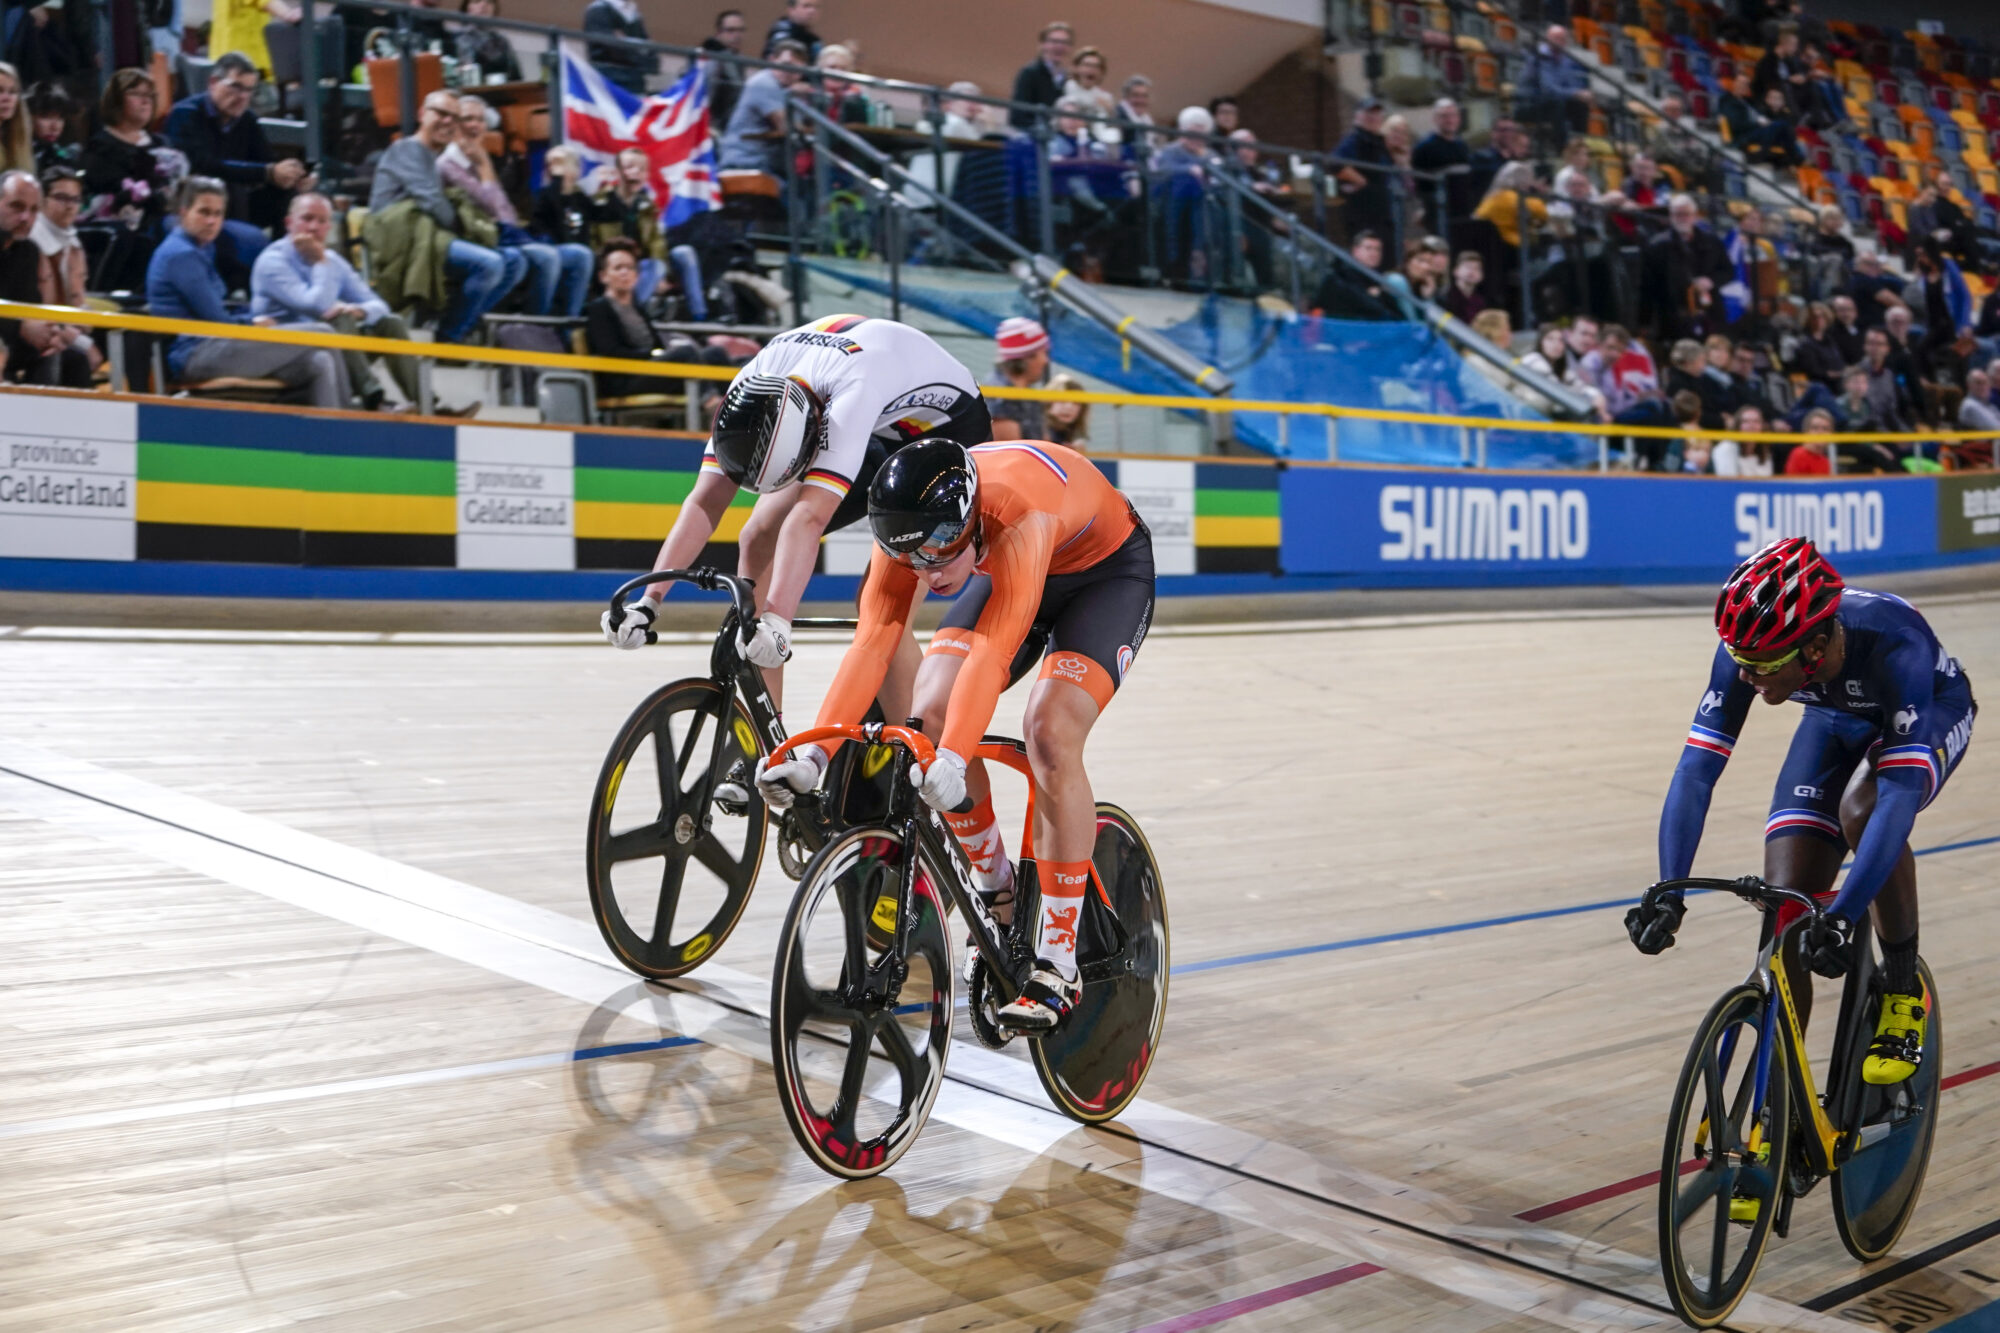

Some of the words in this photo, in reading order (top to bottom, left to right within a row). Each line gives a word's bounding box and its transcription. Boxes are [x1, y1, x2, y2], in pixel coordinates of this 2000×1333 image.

[10, 440, 98, 468] provincie
[747, 413, 773, 480] SPEED
[0, 475, 126, 507] Gelderland
[464, 499, 566, 525] Gelderland
[889, 531, 923, 543] LAZER
[1380, 485, 1588, 560] SHIMANO
[1735, 491, 1883, 556] SHIMANO
[943, 831, 1000, 949] KOGA
